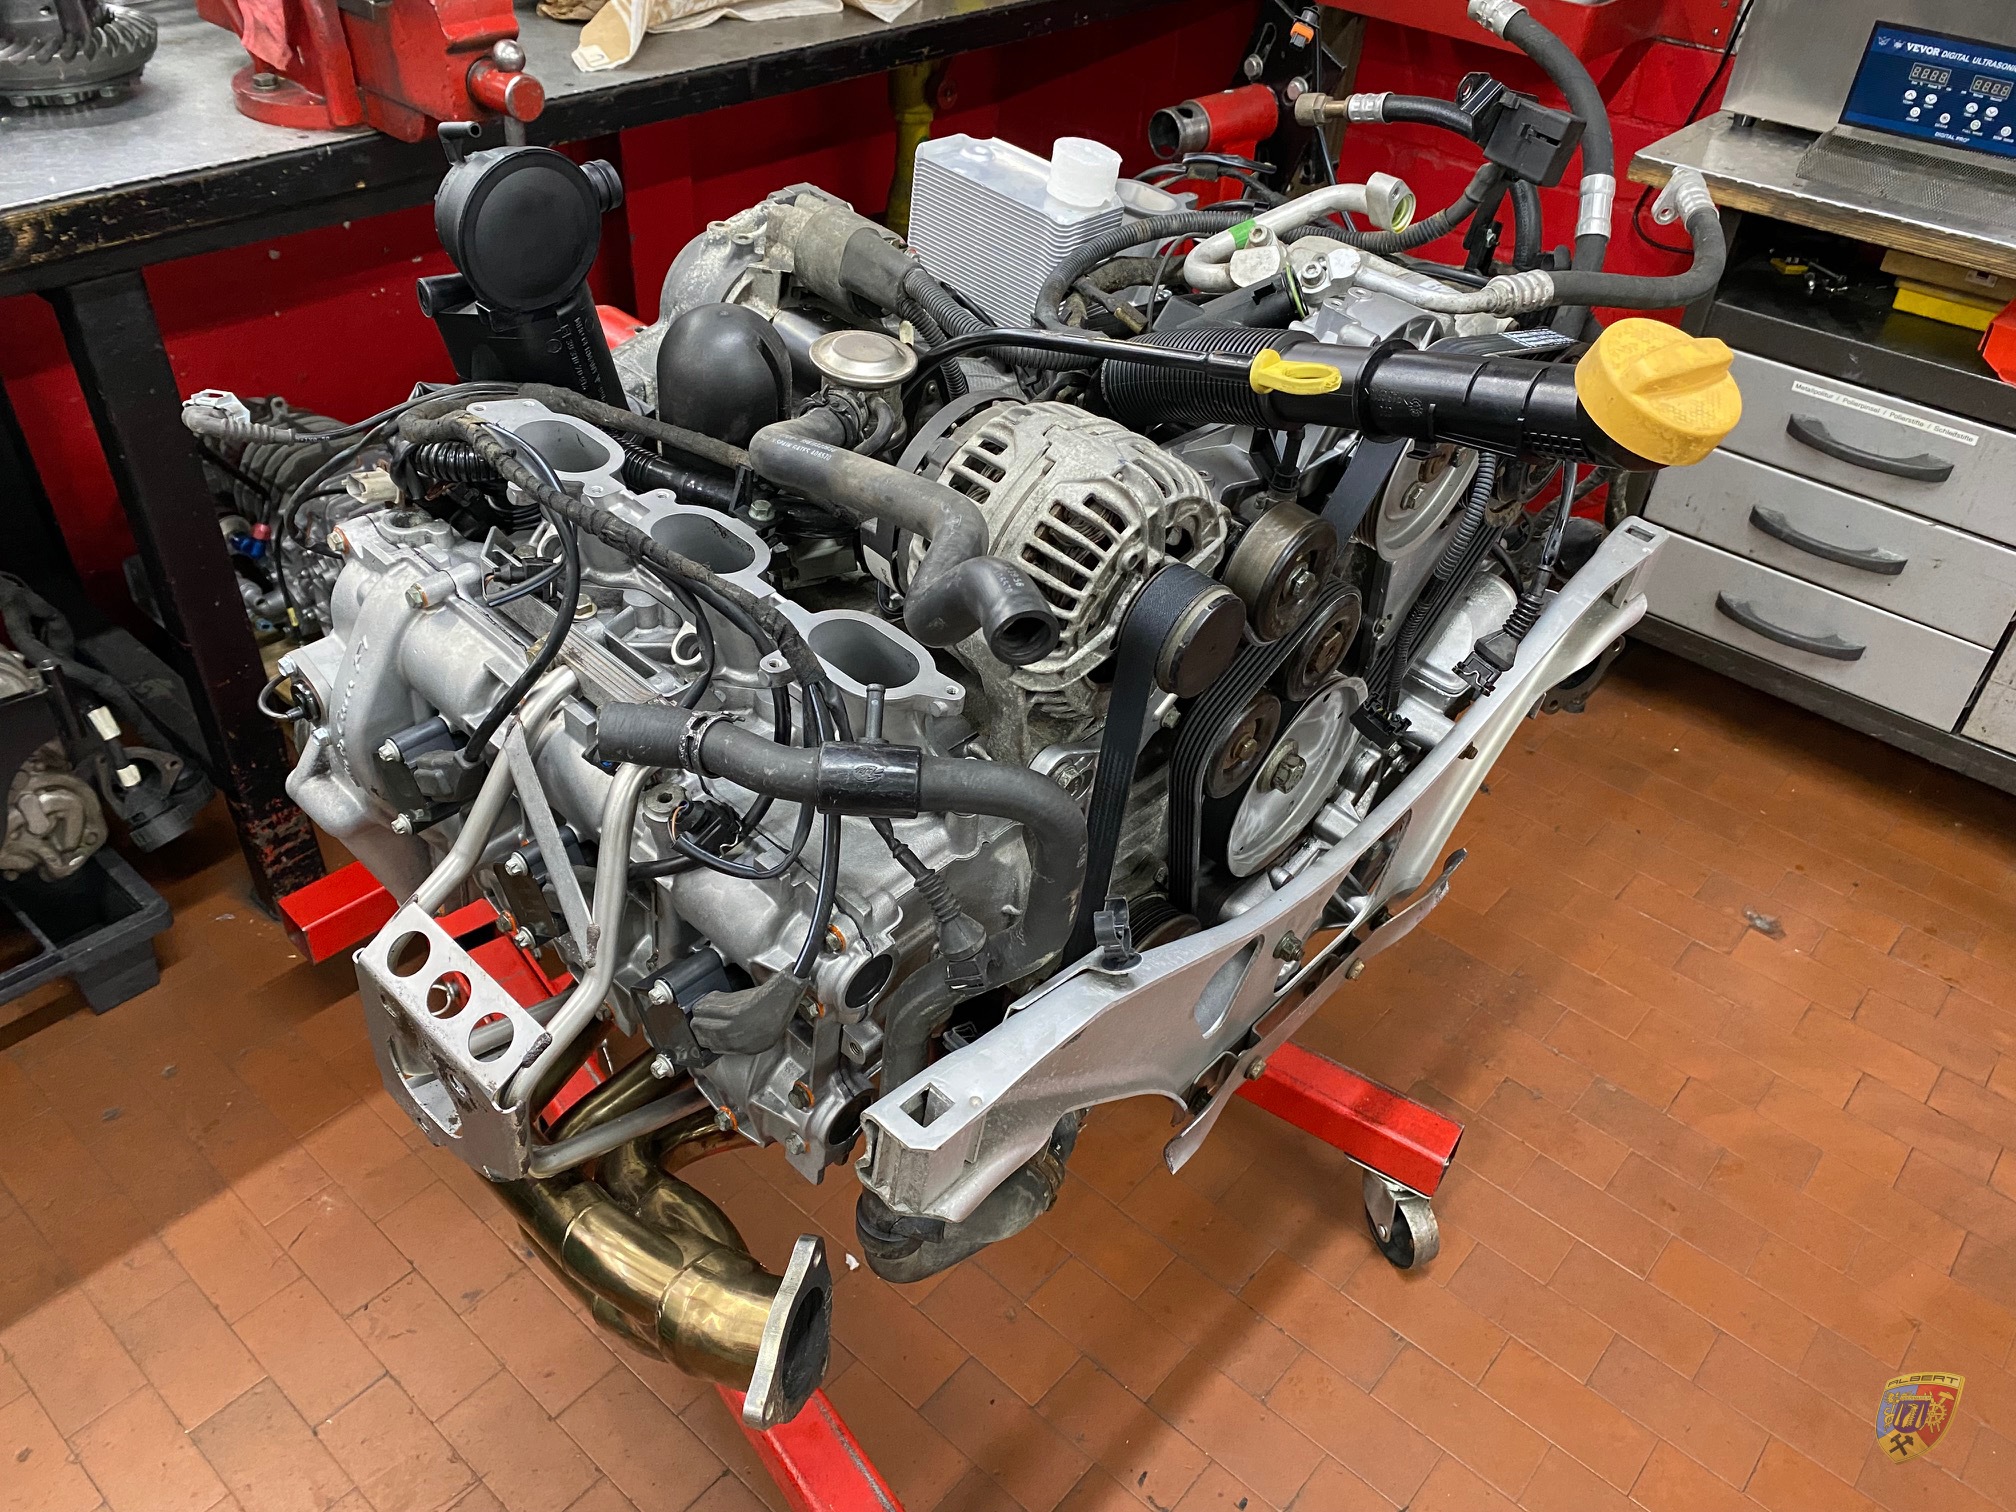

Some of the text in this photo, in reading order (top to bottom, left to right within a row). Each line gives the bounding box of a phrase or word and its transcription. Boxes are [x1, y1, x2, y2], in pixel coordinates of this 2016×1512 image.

[1907, 42, 1940, 56] VEVOR
[1941, 50, 1969, 63] DIGITAL
[1934, 131, 1955, 140] DIGITAL
[1795, 383, 1834, 399] Metallpolitur
[1842, 397, 1881, 414] Polierpinsel
[1889, 411, 1924, 427] Polierstifte
[1934, 426, 1975, 443] Schleifstifte
